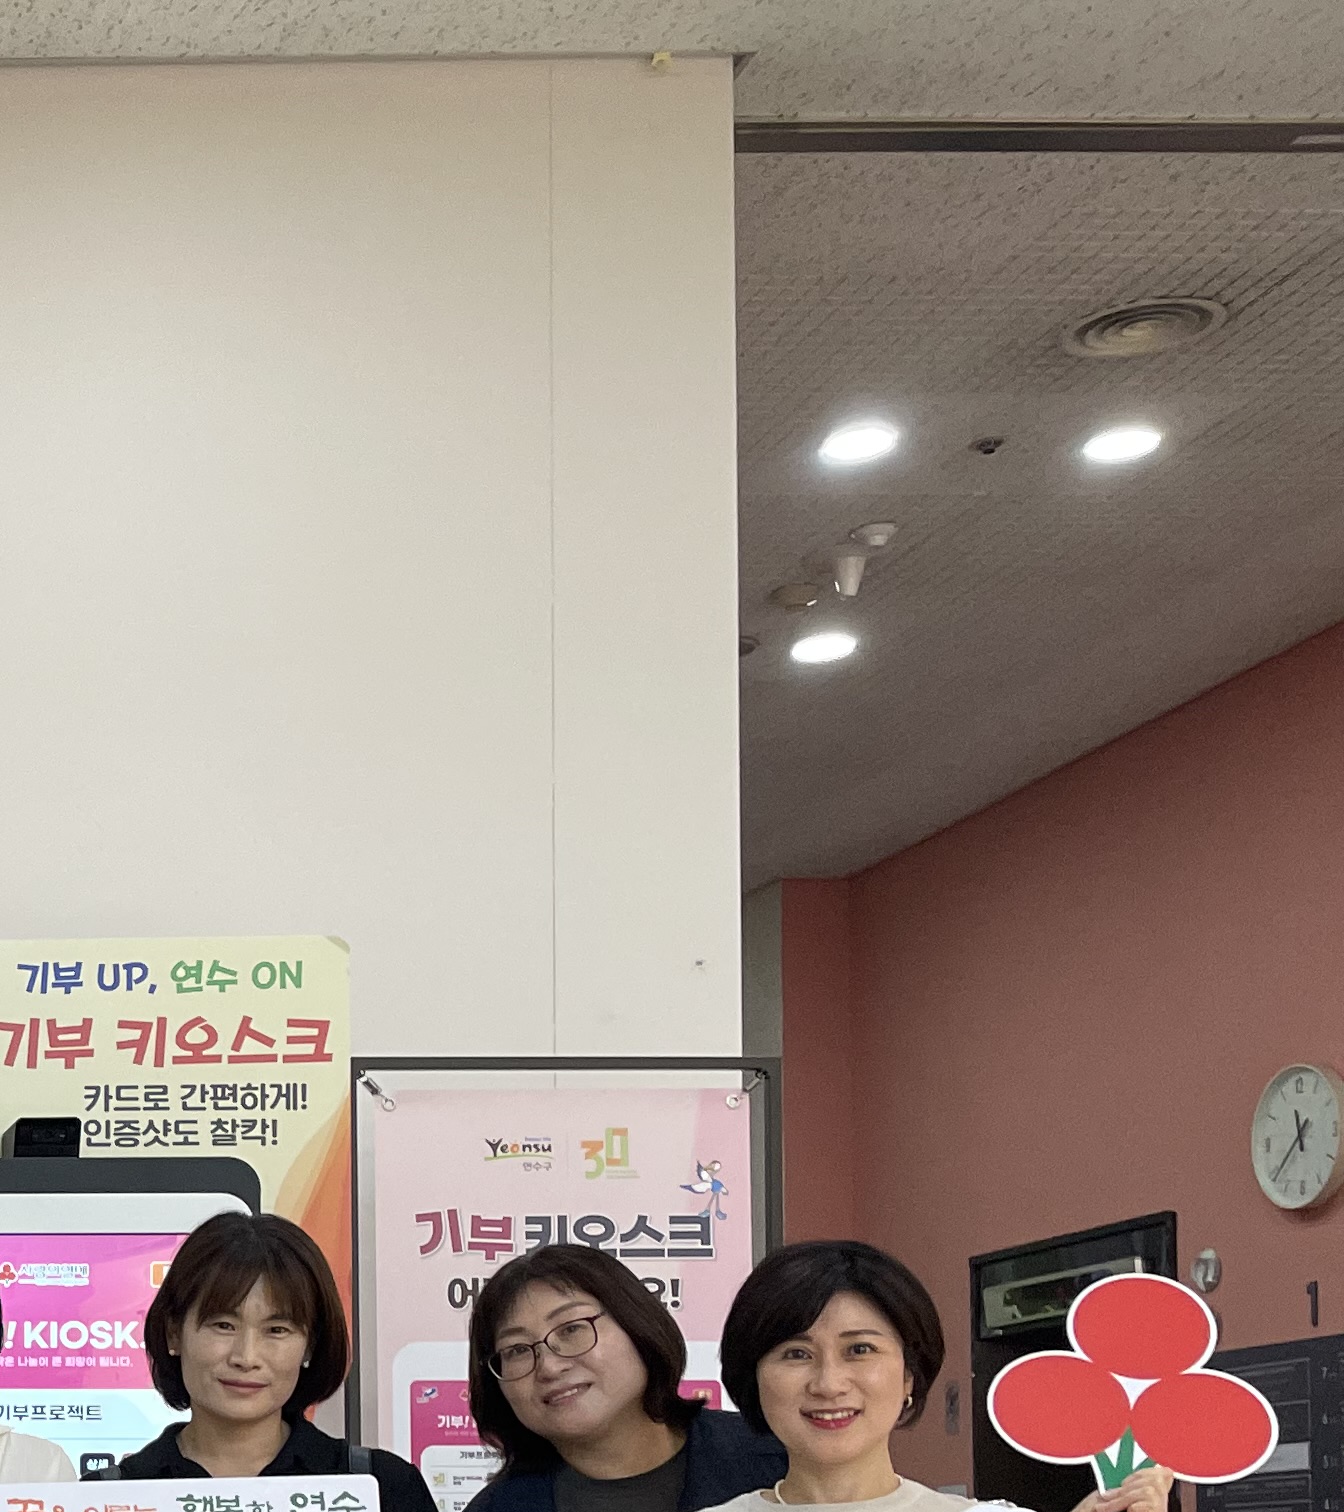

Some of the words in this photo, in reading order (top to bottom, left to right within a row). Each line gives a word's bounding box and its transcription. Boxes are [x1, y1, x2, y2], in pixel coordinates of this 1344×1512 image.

[17, 961, 84, 995] 기부
[97, 962, 157, 994] UP,
[170, 960, 239, 993] 연수
[251, 961, 303, 990] ON
[116, 1016, 334, 1068] 키오스크
[84, 1084, 169, 1111] 카드로
[180, 1083, 308, 1111] 간편하게!
[83, 1118, 200, 1149] 인증샷도
[210, 1118, 279, 1148] 찰칵!
[485, 1137, 552, 1158] Yeonsu
[415, 1209, 514, 1261] 기부
[525, 1214, 714, 1258] 키오스크
